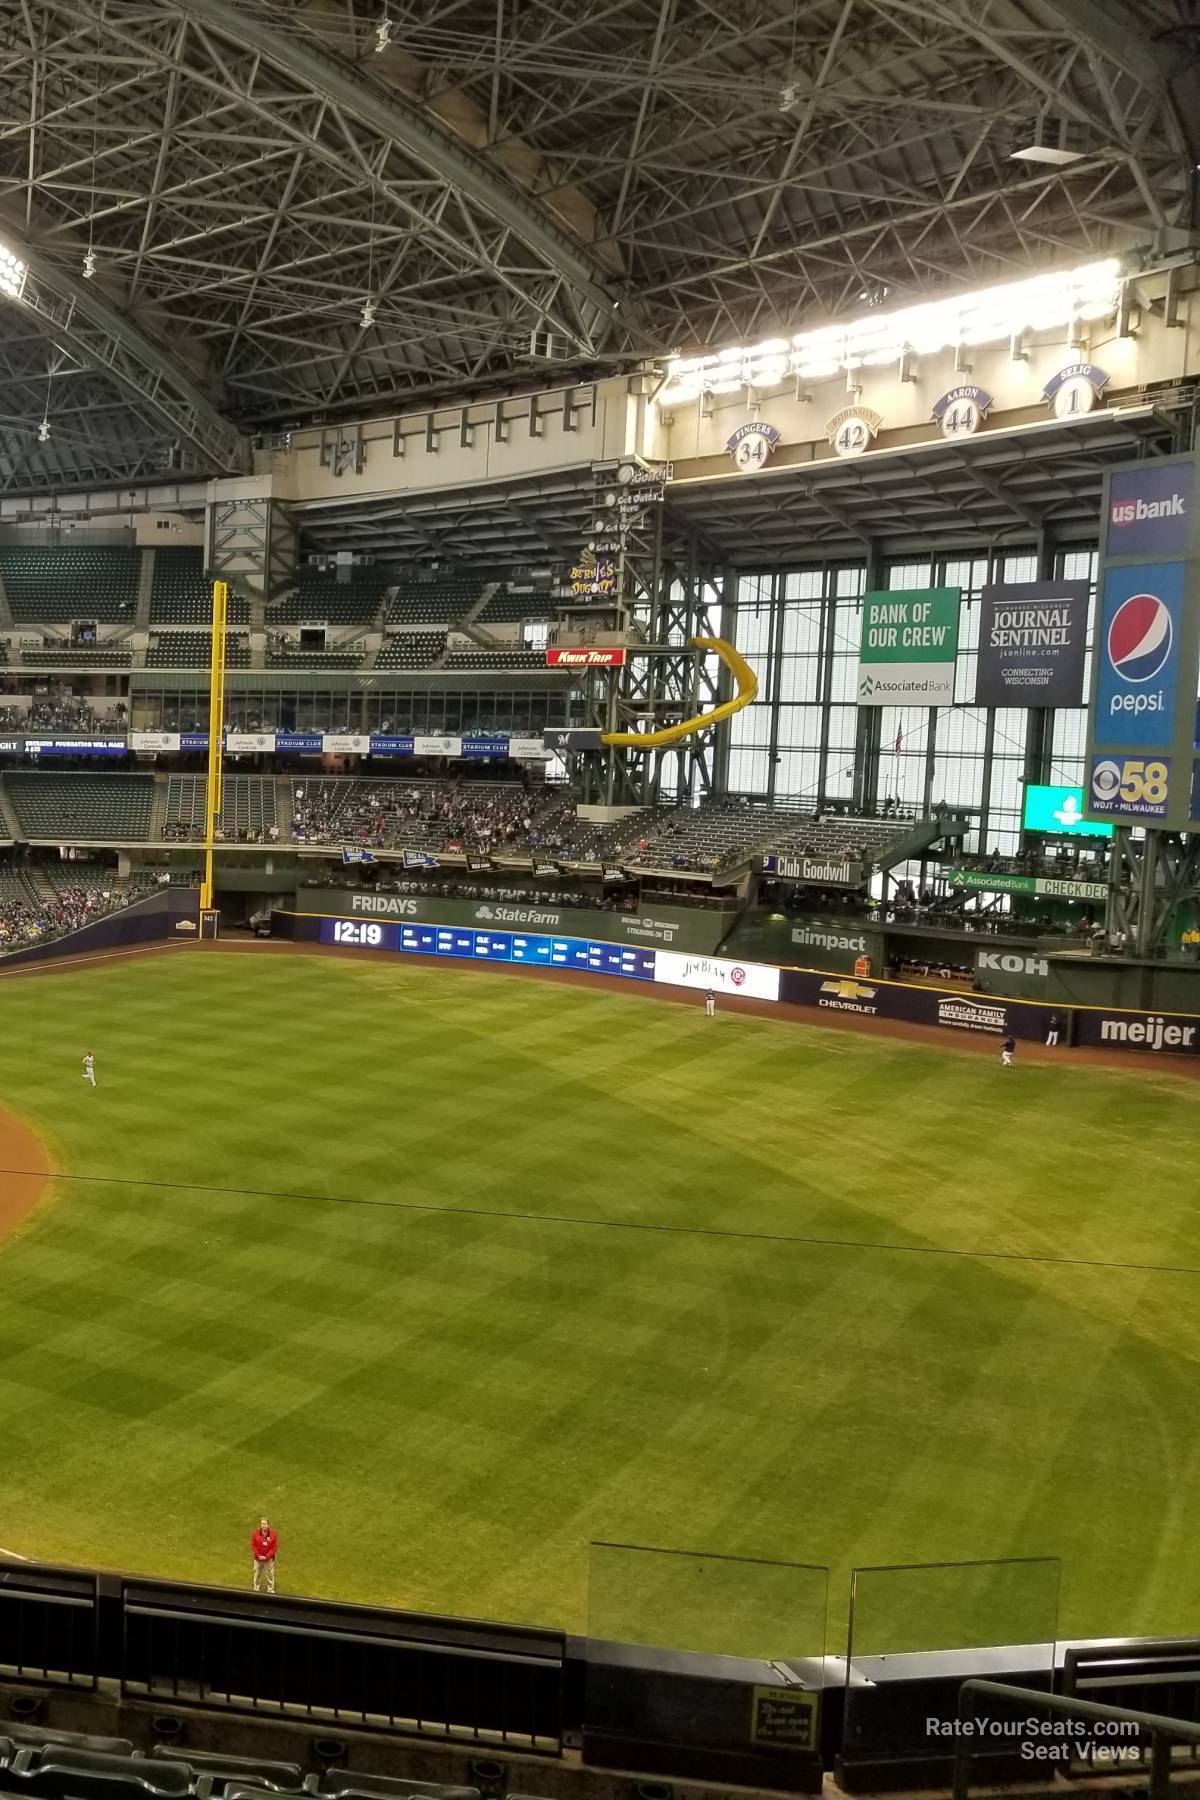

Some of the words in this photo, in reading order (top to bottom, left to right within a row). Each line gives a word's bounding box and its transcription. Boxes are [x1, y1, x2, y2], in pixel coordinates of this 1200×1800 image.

[1060, 363, 1092, 380] SELIG
[946, 387, 979, 403] AARON
[1067, 388, 1080, 412] 1
[945, 408, 974, 433] 44
[736, 423, 772, 440] FINGERS
[839, 427, 864, 450] 42
[739, 441, 765, 463] 34
[569, 561, 614, 580] BERNIE'S
[869, 604, 907, 624] BANK
[913, 603, 931, 622] OF
[991, 609, 1072, 631] JOURNAL
[868, 627, 897, 648] OUR
[990, 628, 1071, 647] SENTINEL
[557, 652, 588, 663] KWIK
[588, 652, 613, 663] TRIP
[1000, 648, 1060, 659] jsonline.com
[1001, 668, 1054, 677] CONNECTING
[1004, 677, 1049, 685] WISCONSIN
[1111, 690, 1163, 716] pepsi
[1120, 761, 1168, 804] 58
[1093, 801, 1113, 810] WDJT
[1119, 803, 1166, 814] MILWAUKEE
[777, 857, 800, 877] Club
[803, 859, 850, 882] Goodwill
[1044, 881, 1083, 897] CHECK
[1085, 885, 1109, 898] DEC
[352, 895, 417, 915] FRIDAYS
[333, 920, 382, 945] 12:19
[626, 927, 654, 937] STREAMING
[803, 929, 866, 952] impact
[819, 998, 877, 1015] CHEVROLET
[939, 1003, 976, 1014] AMERICAN
[978, 1009, 1005, 1018] FAMILY
[1101, 1016, 1197, 1050] meijer
